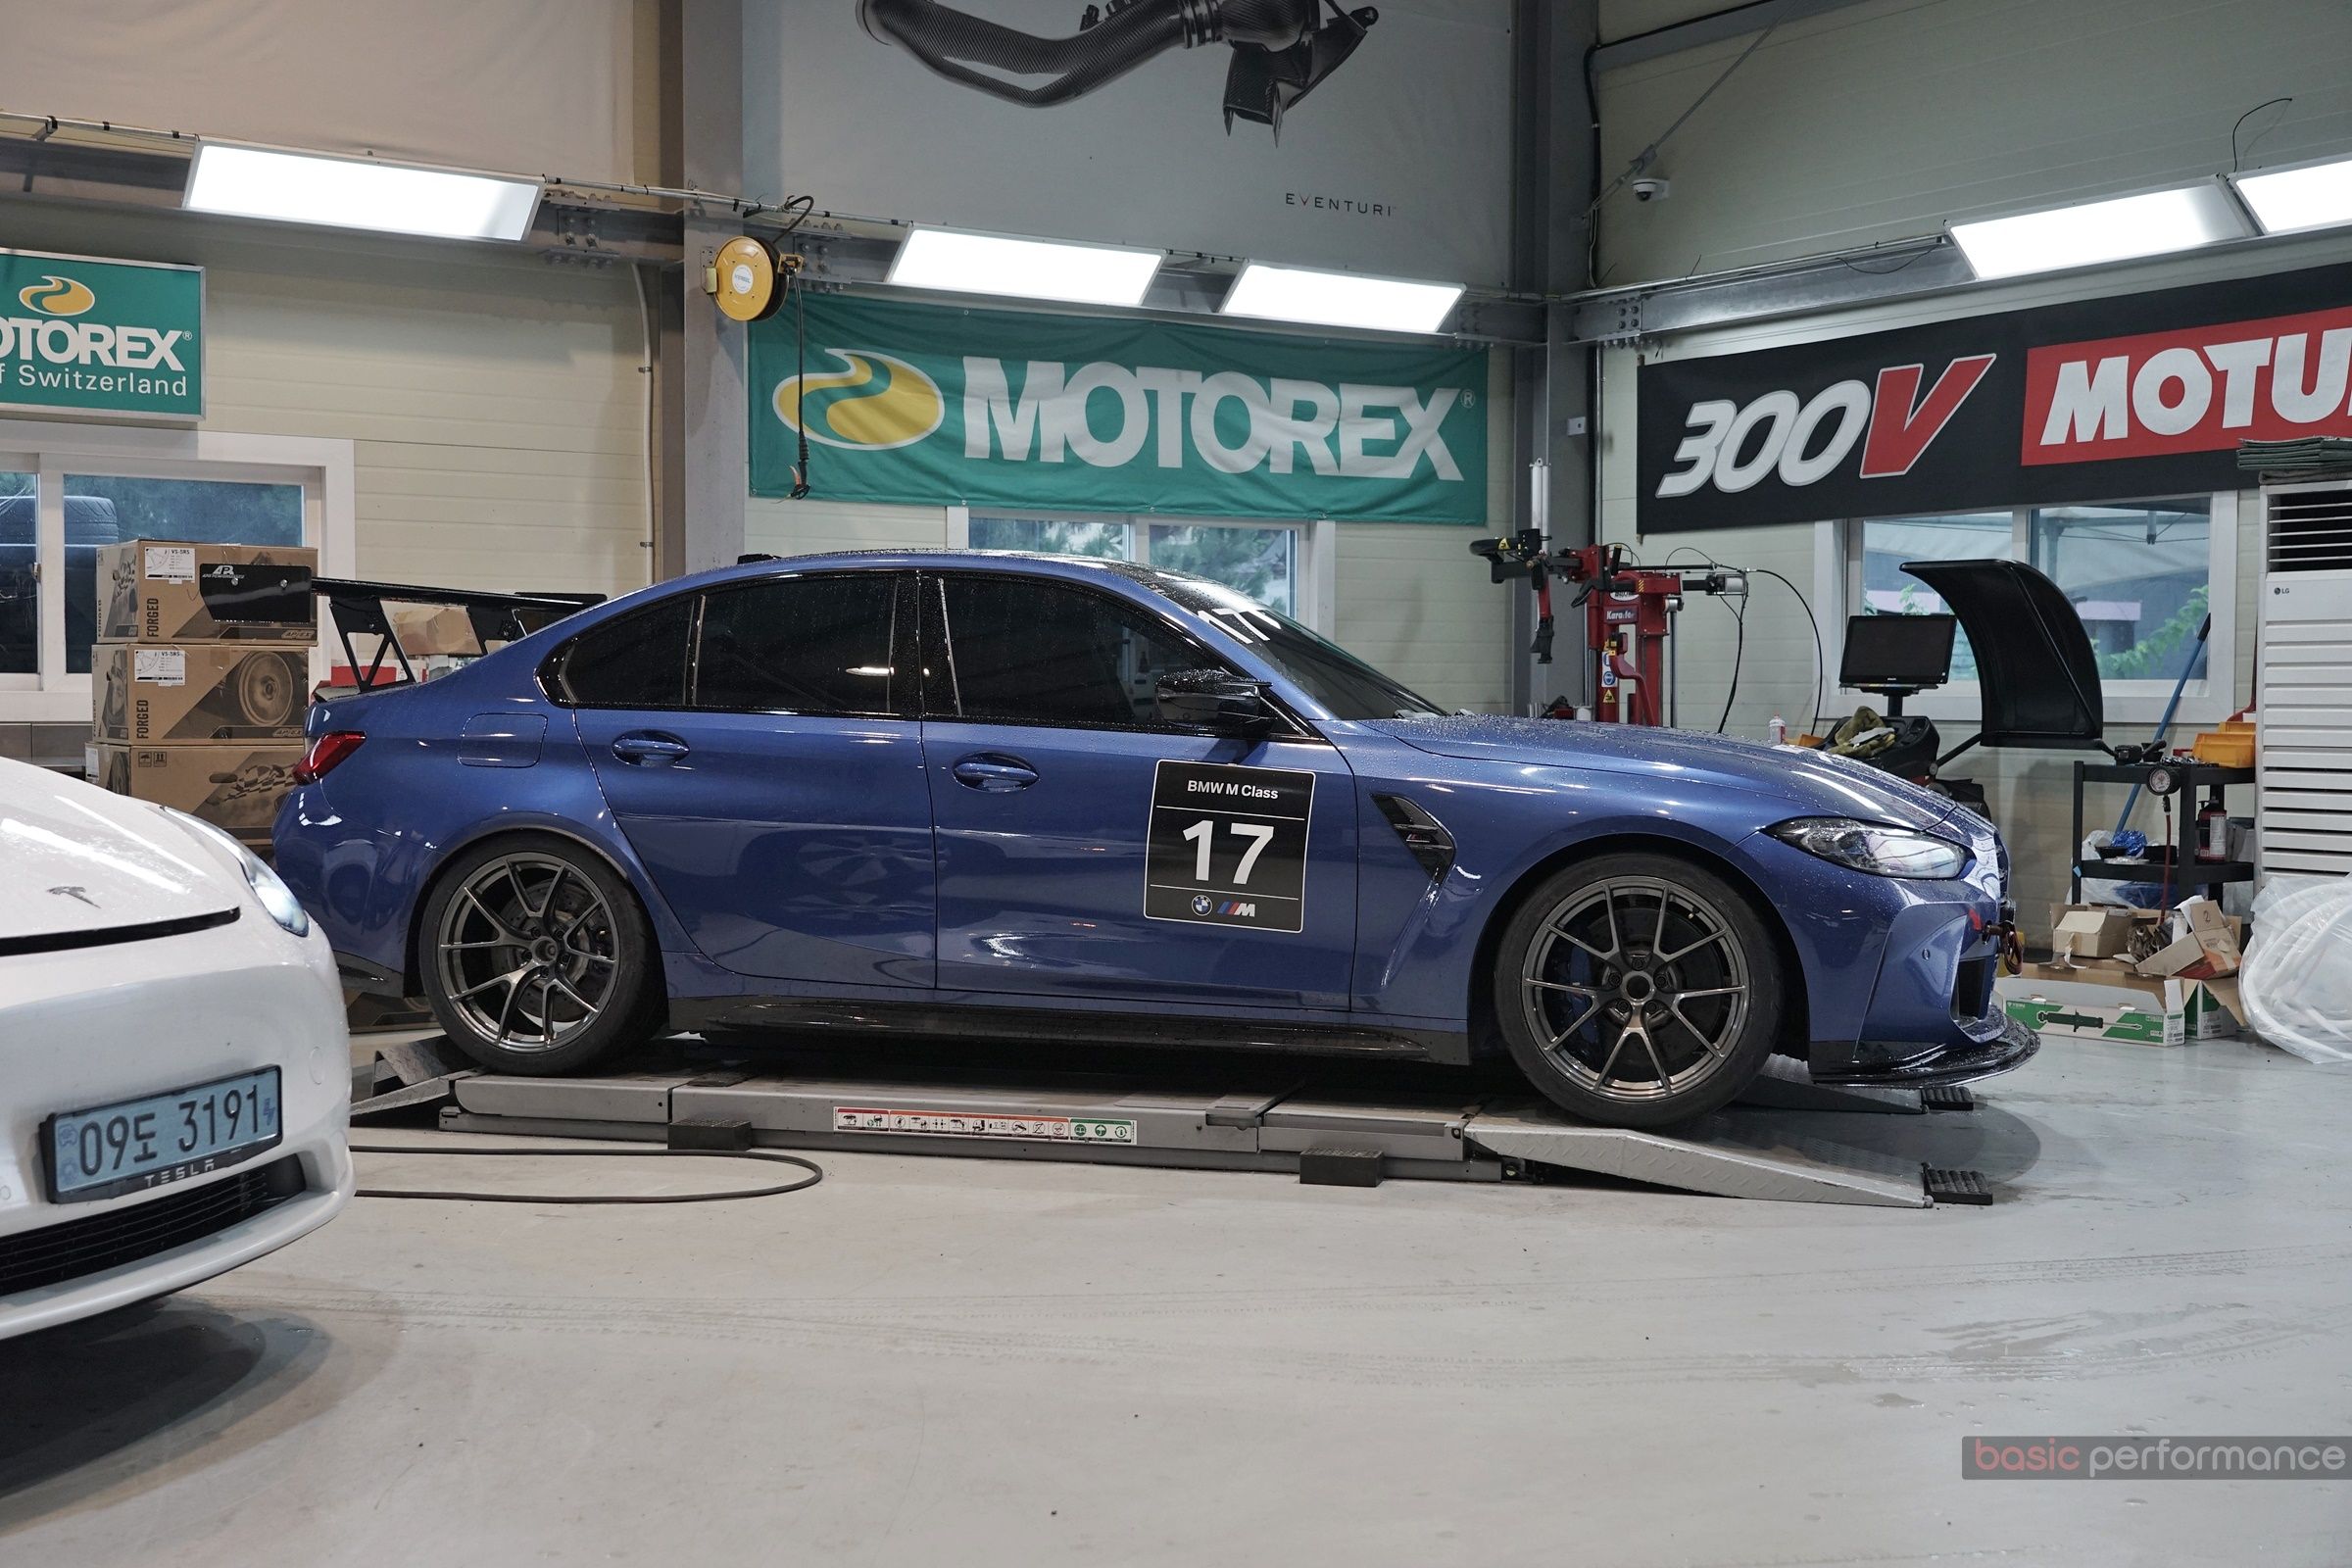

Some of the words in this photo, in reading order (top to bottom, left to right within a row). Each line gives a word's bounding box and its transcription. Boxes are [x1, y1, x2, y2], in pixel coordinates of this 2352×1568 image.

[1285, 192, 1392, 217] EVENTURI
[19, 364, 187, 397] Switzerland
[2039, 326, 2352, 447] MOTU
[962, 354, 1465, 482] MOTOREX
[1654, 353, 1997, 500] 300V
[147, 598, 159, 638] FORGED
[137, 699, 149, 740] FORGED
[1187, 779, 1225, 794] BMW
[1226, 784, 1239, 796] M
[1241, 784, 1279, 800] Class
[1182, 819, 1275, 885] 17
[2203, 909, 2211, 923] 2
[79, 1111, 158, 1176] 09도
[177, 1084, 258, 1152] 3191
[144, 1159, 216, 1188] TESLA
